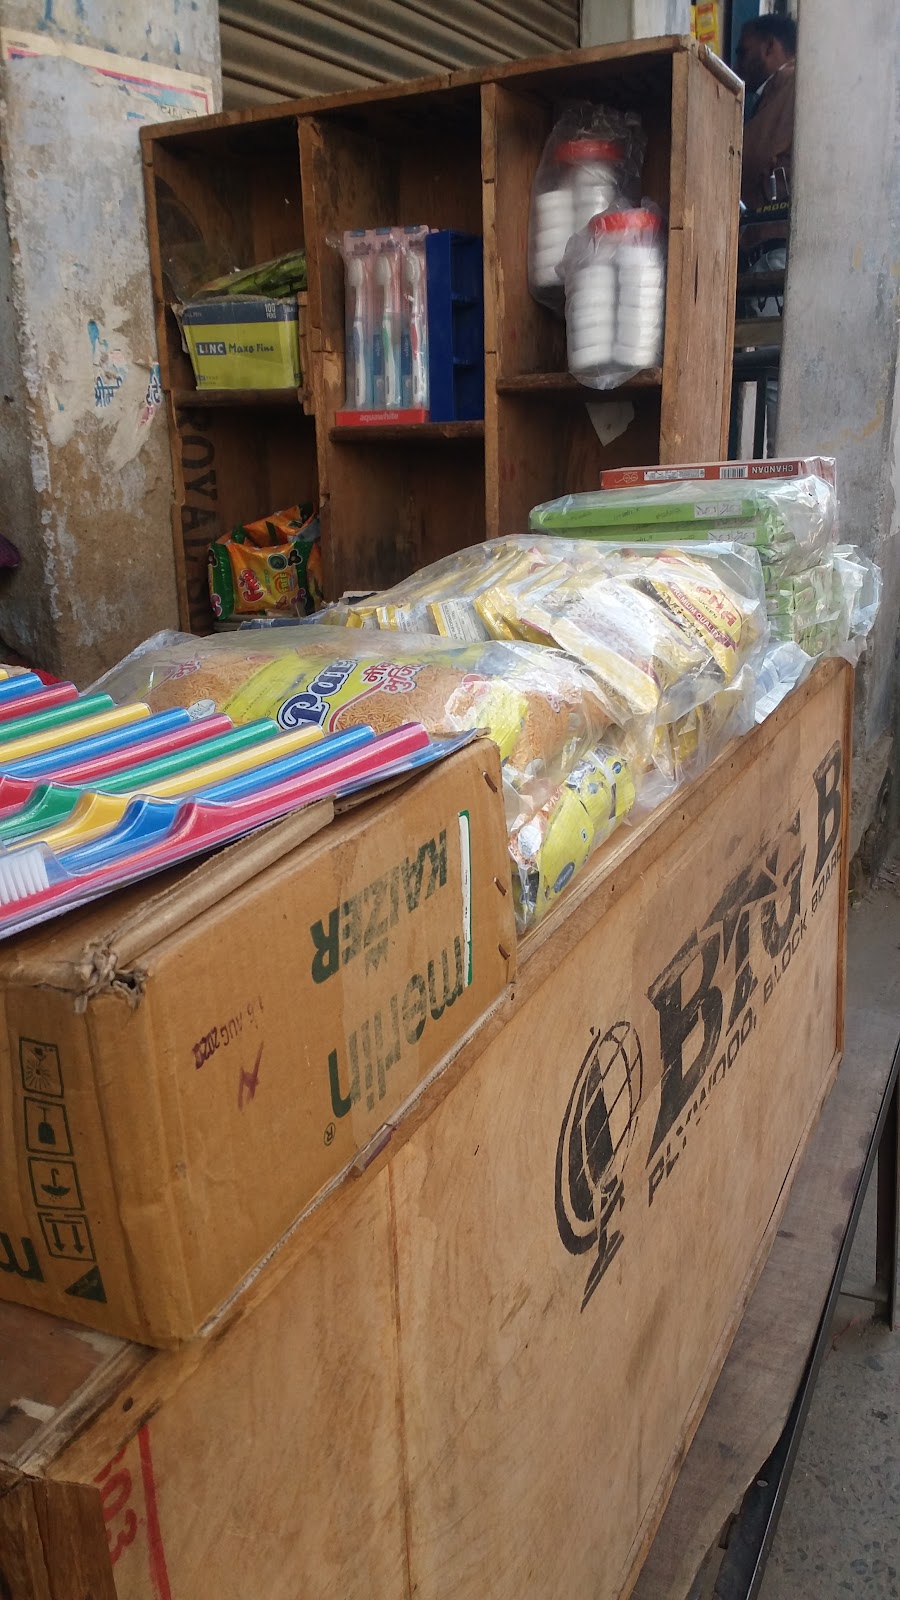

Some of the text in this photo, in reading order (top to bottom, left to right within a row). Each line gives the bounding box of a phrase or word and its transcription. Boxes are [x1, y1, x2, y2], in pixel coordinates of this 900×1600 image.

[264, 303, 276, 313] 100
[199, 344, 224, 354] LINC
[359, 413, 399, 423] aquawhite
[751, 464, 794, 474] CHANDAN
[670, 583, 698, 617] PREMIUM
[696, 610, 723, 640] QUALITY
[812, 738, 842, 887] B
[310, 828, 447, 984] KAIZER
[763, 910, 808, 1007] BLOCK
[220, 1012, 242, 1047] AUG
[328, 936, 463, 1118] merlin
